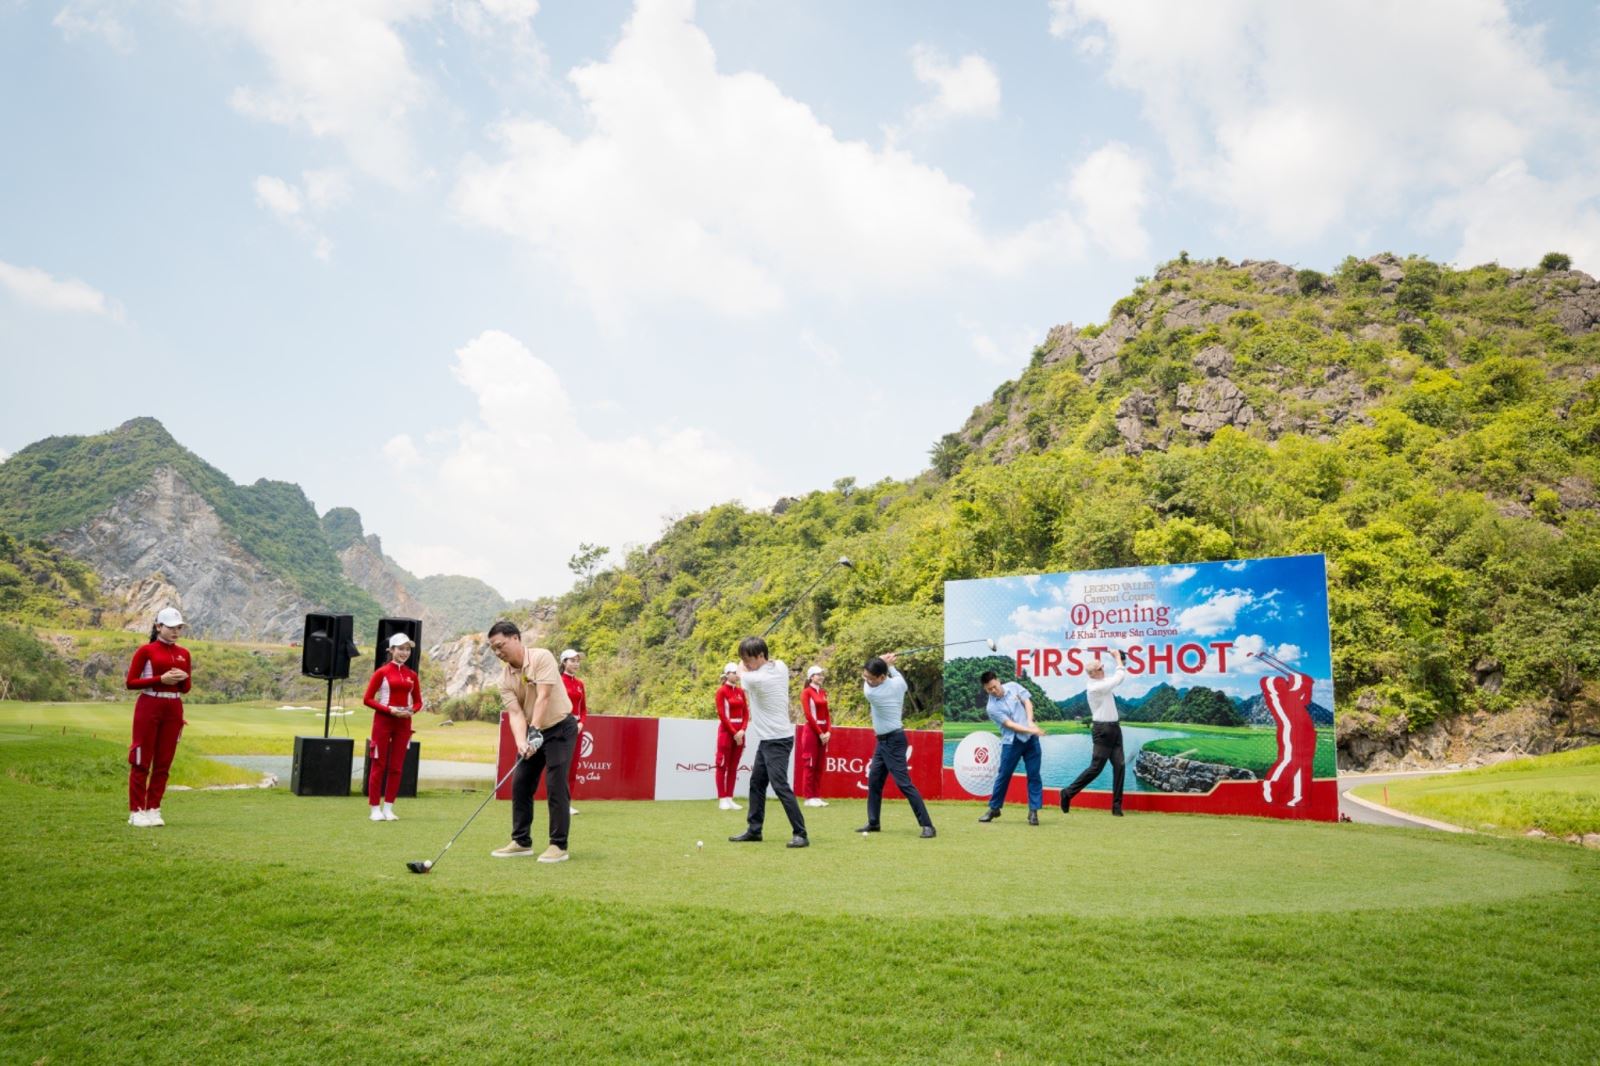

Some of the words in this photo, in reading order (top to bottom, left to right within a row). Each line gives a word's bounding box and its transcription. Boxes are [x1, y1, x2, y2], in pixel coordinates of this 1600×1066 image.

[1084, 584, 1120, 594] LEGEND
[1122, 581, 1155, 591] VALLEY
[1084, 594, 1120, 605] Canyon
[1122, 592, 1155, 601] Course
[1070, 603, 1170, 629] Opening
[1146, 627, 1178, 637] Canyon
[1126, 642, 1234, 675] SHOT
[582, 761, 612, 770] VALLEY
[825, 757, 864, 773] BRG
